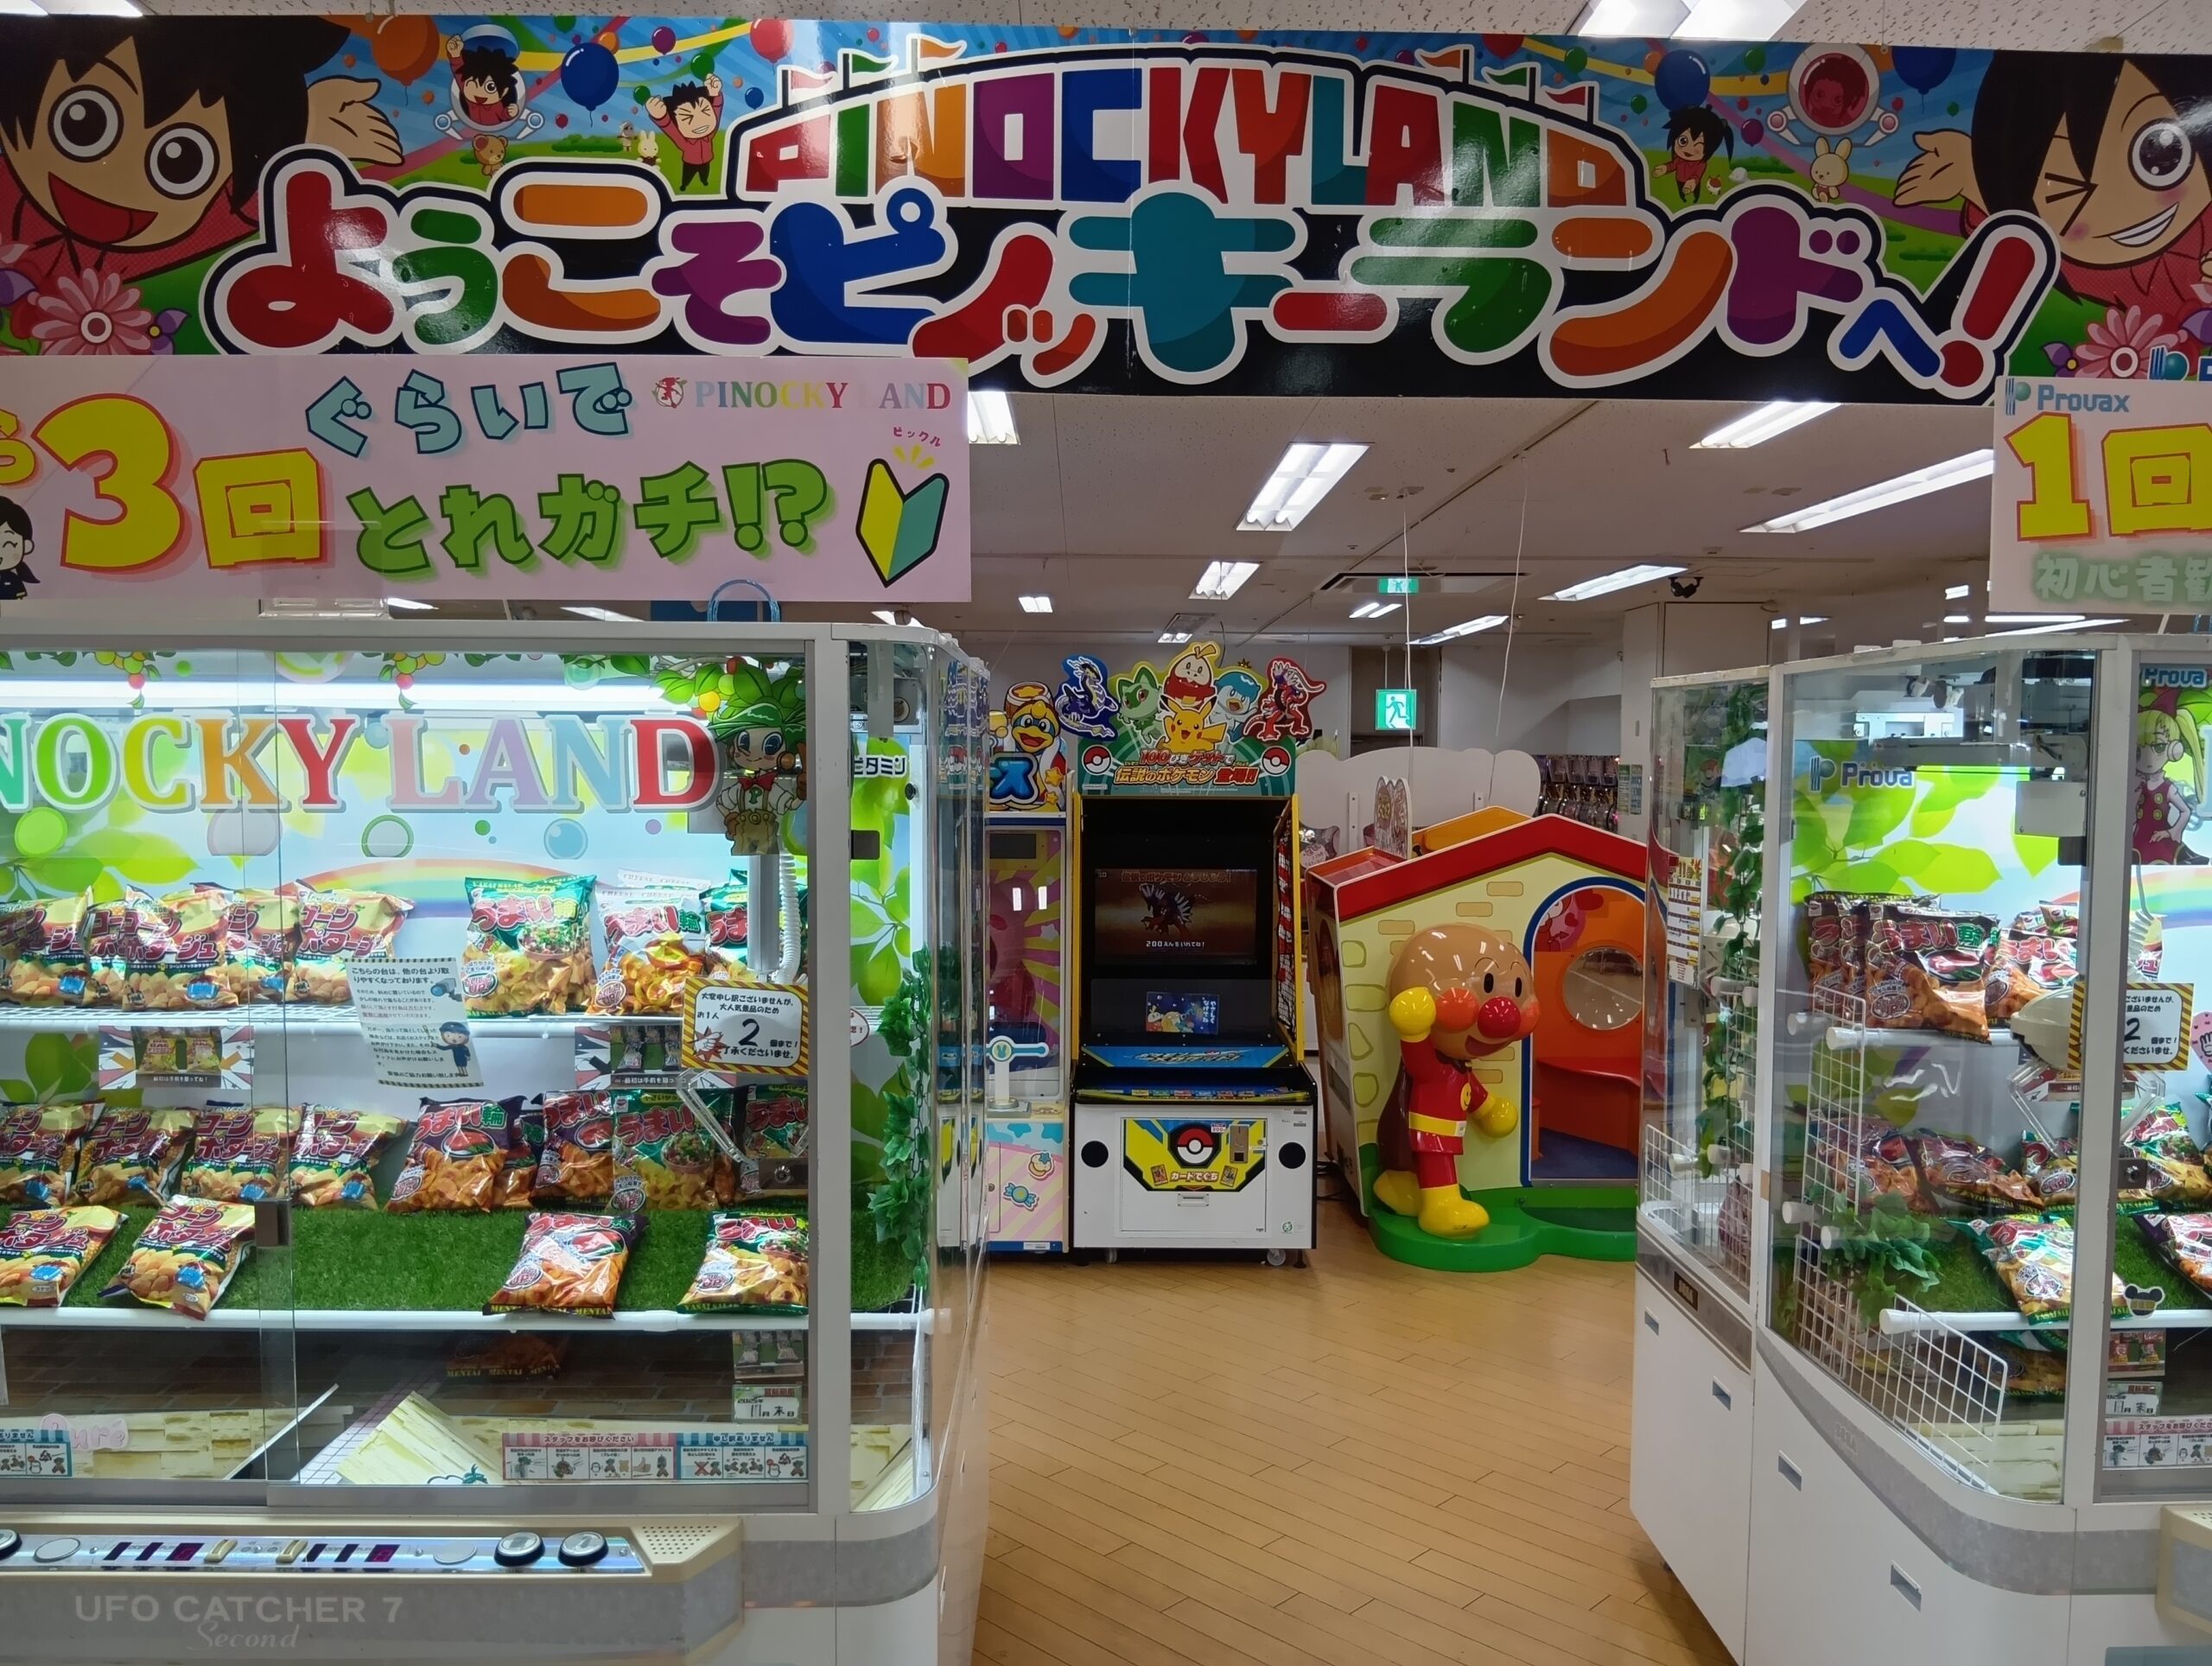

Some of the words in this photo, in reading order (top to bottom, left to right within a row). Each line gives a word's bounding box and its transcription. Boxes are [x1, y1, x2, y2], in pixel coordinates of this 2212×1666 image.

[744, 65, 1630, 209] PINOCKYLAND
[695, 381, 849, 409] PINOCKY
[858, 382, 951, 410] AND
[2037, 385, 2130, 413] Provax
[306, 363, 633, 458] ぐらいで
[2004, 411, 2212, 542] 1回
[347, 458, 828, 575] とれガチ!?
[385, 717, 716, 806] LAND
[707, 906, 748, 945] うま
[696, 1011, 720, 1020] お1人
[719, 1004, 780, 1014] 大人気景品のため
[738, 1018, 760, 1047] 2
[2124, 1017, 2141, 1042] 2
[716, 1046, 794, 1059] 了承くださいませ。
[197, 1113, 253, 1136] コーン
[414, 1103, 507, 1141] うまい輪
[615, 1104, 696, 1146] うまい
[543, 1434, 636, 1444] スタッフをお呼びください
[713, 1434, 774, 1443] 申し訳ありません
[75, 1594, 160, 1623] UFO
[174, 1594, 366, 1623] CATCHER
[383, 1596, 404, 1622] 7
